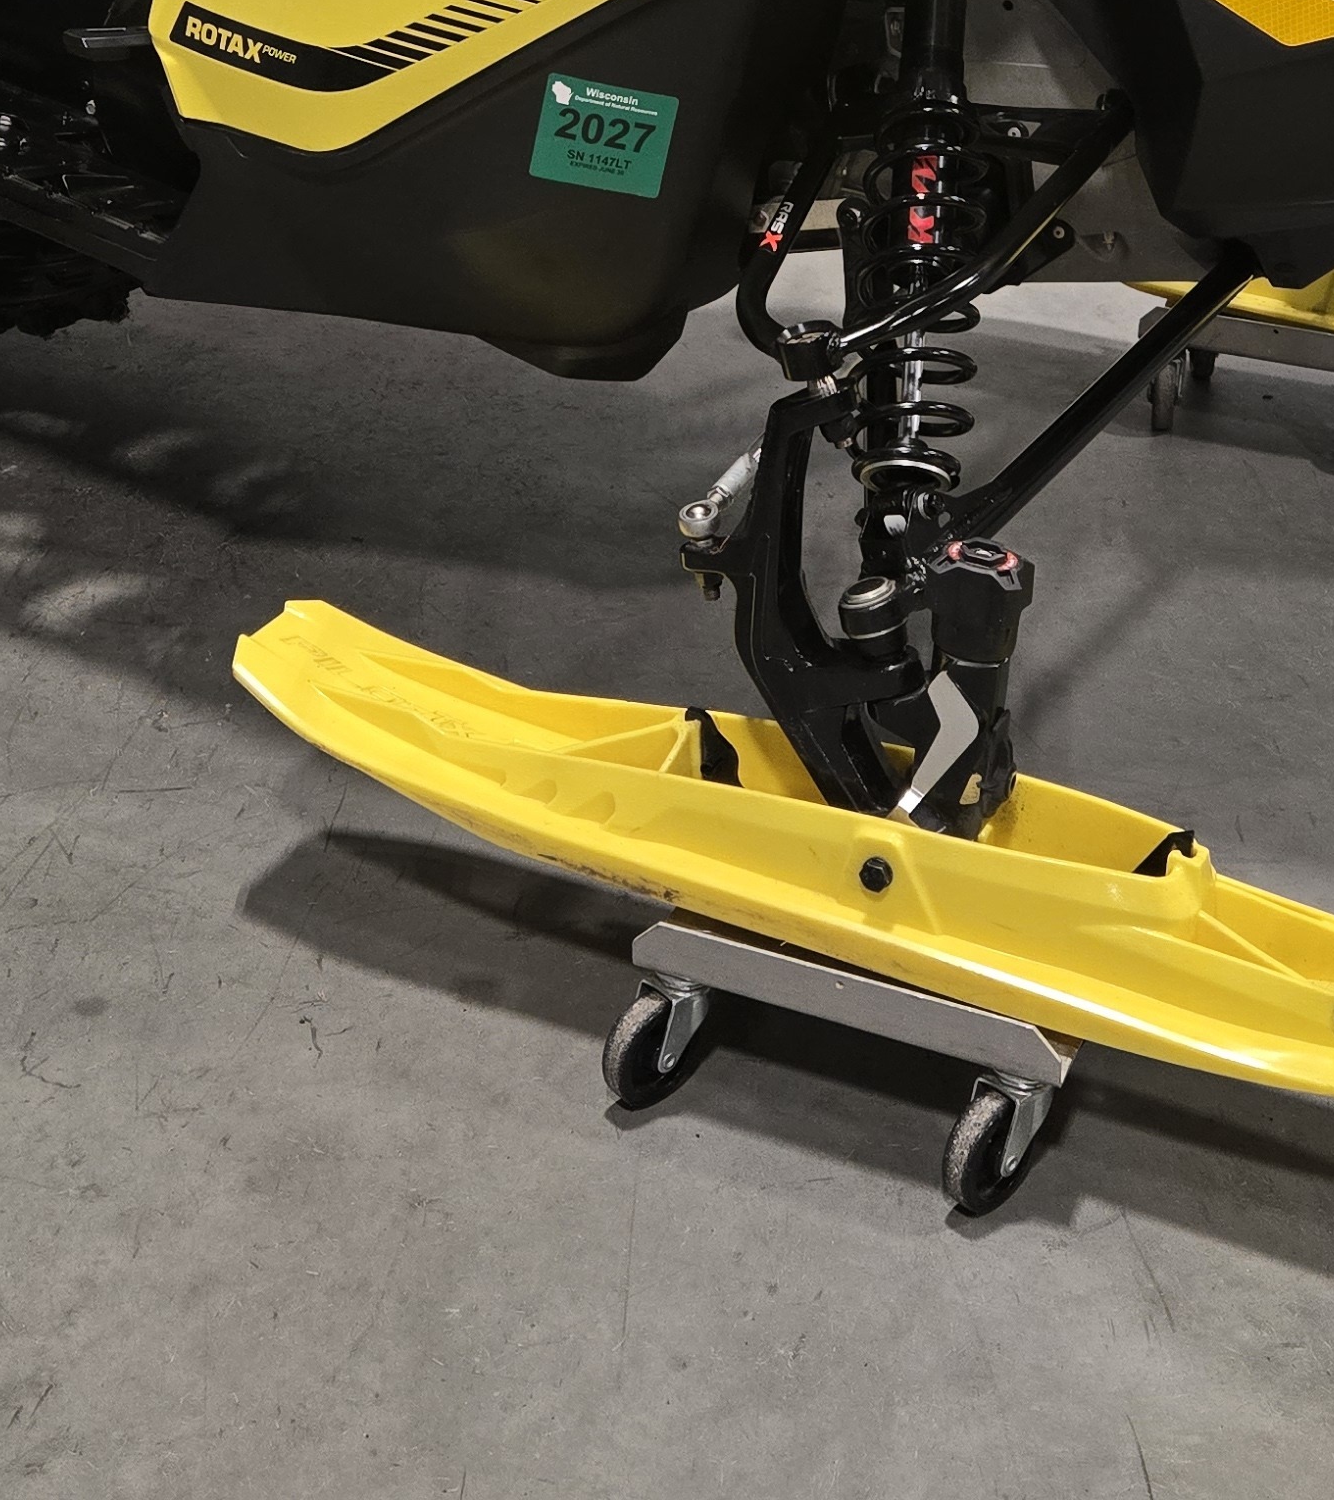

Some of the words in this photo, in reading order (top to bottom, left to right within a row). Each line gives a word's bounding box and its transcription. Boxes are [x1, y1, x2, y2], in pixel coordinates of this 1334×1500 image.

[185, 15, 264, 64] ROTAX
[262, 44, 297, 64] POWER
[586, 87, 638, 106] Wisconsin
[554, 108, 657, 153] 2027
[567, 149, 585, 161] SN
[589, 153, 632, 170] 1147LT
